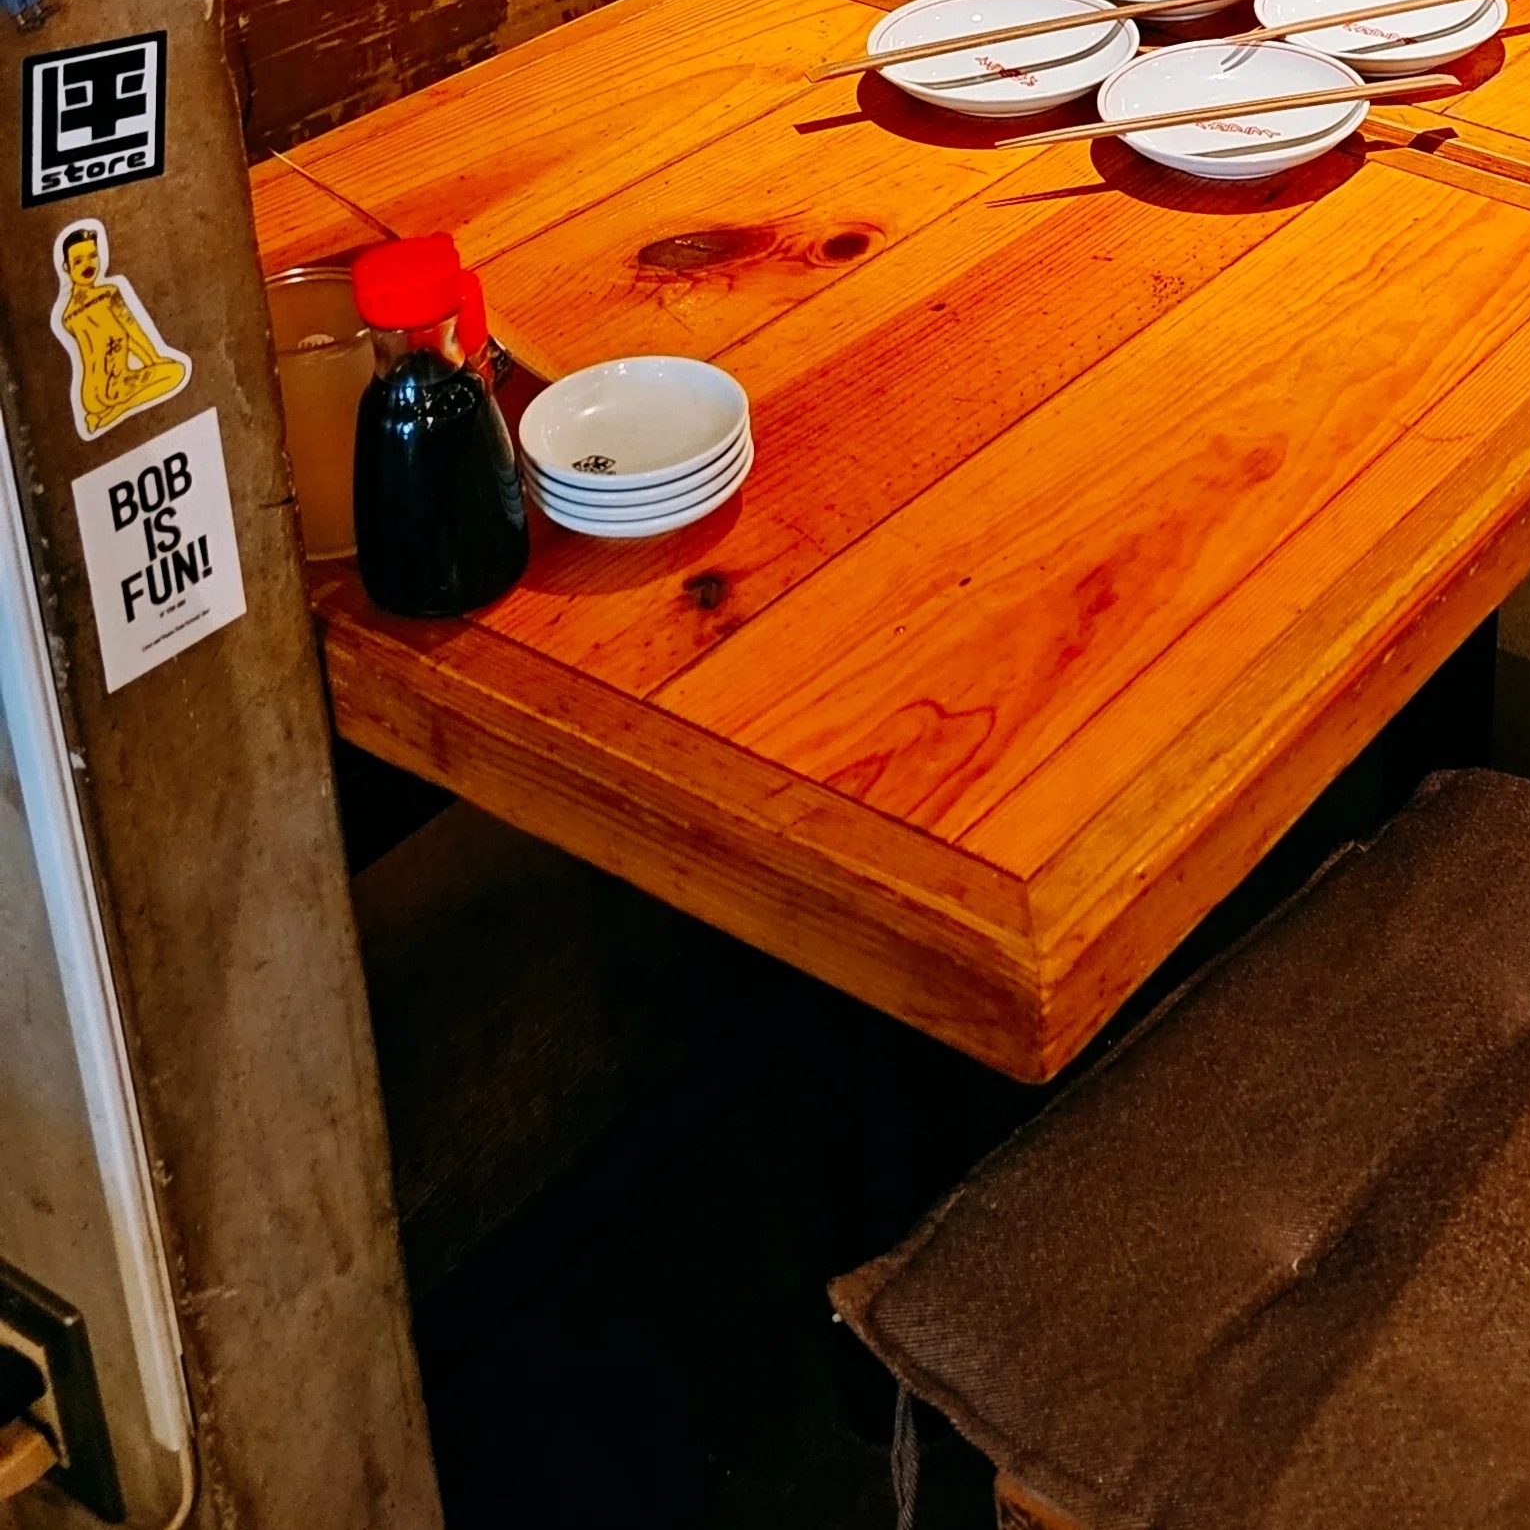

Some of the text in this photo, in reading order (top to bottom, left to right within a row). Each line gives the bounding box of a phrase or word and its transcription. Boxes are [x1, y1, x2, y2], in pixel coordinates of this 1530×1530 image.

[41, 150, 147, 192] store
[108, 451, 193, 533] BOB
[143, 506, 182, 563] IS
[120, 534, 213, 624] FUN!
